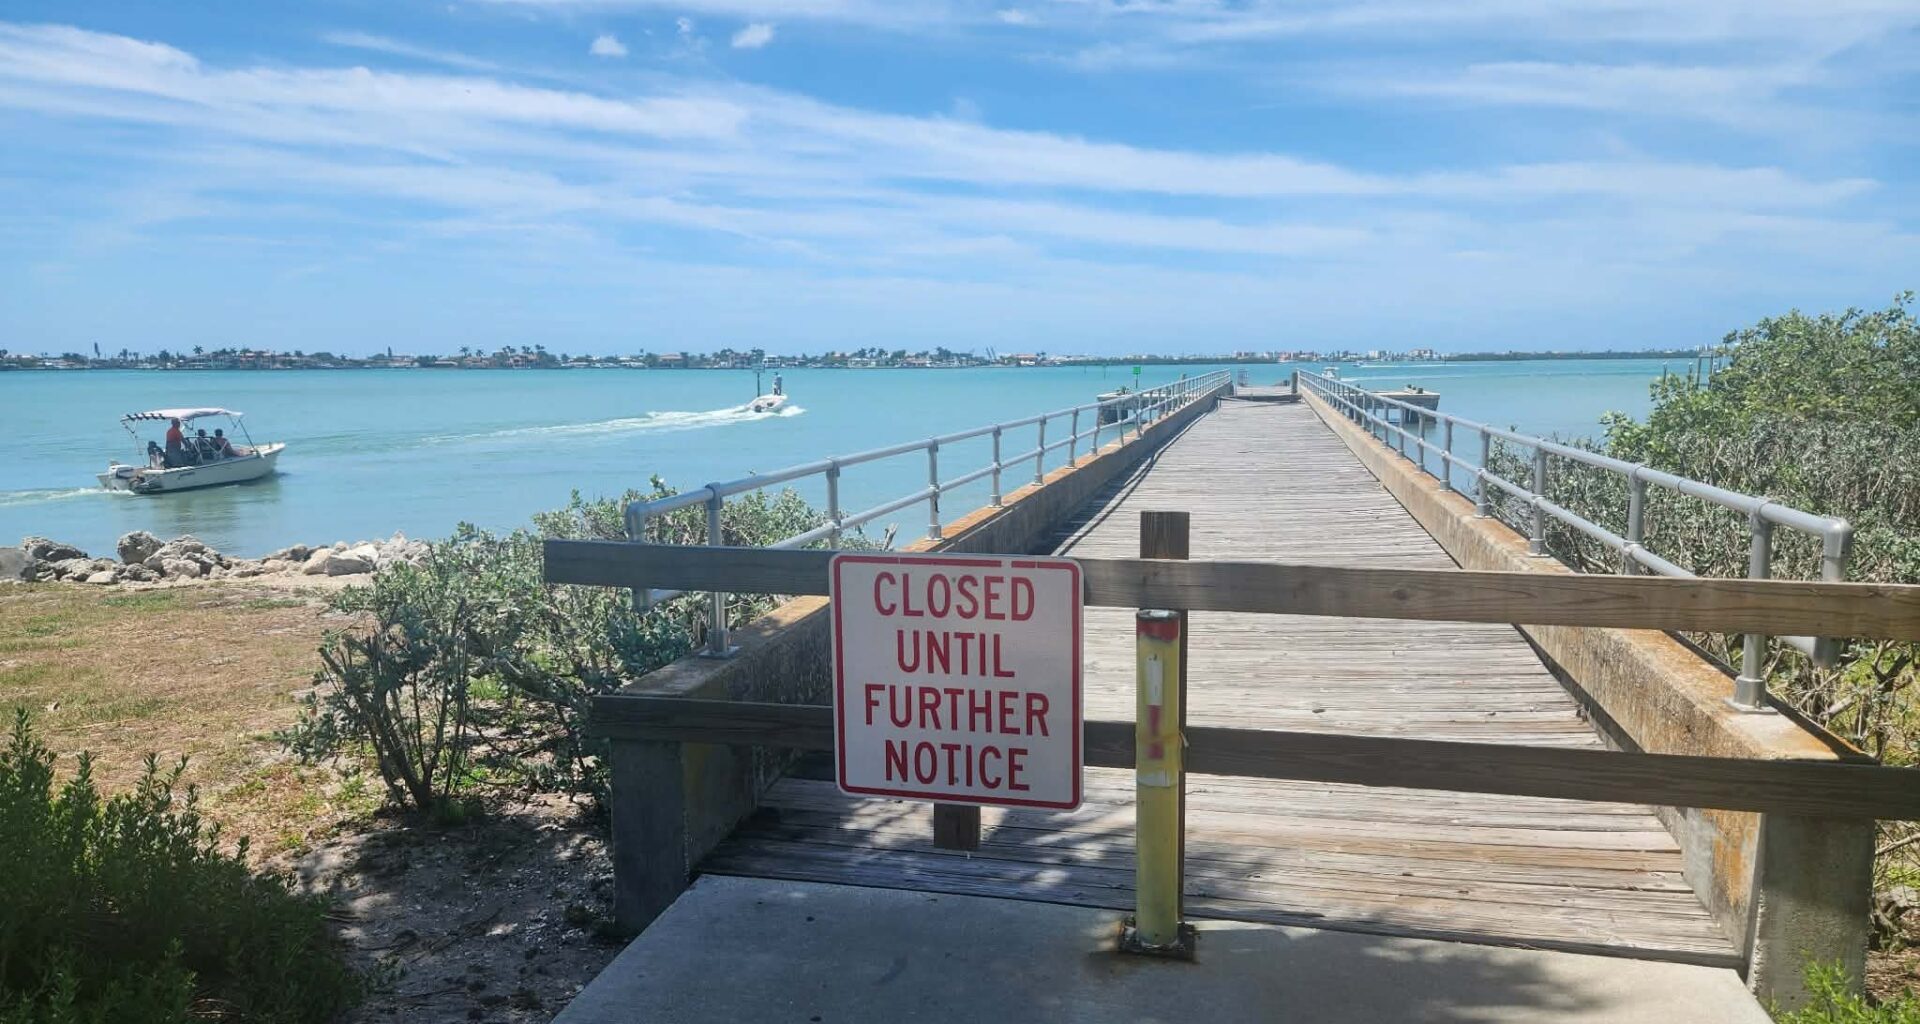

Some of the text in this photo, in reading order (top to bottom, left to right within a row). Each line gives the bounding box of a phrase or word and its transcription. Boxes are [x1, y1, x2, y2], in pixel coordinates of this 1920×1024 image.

[873, 571, 1035, 622] CLOSED
[897, 629, 1015, 678] UNTIL
[864, 683, 1050, 737] FURTHER
[885, 739, 1030, 792] NOTICE
